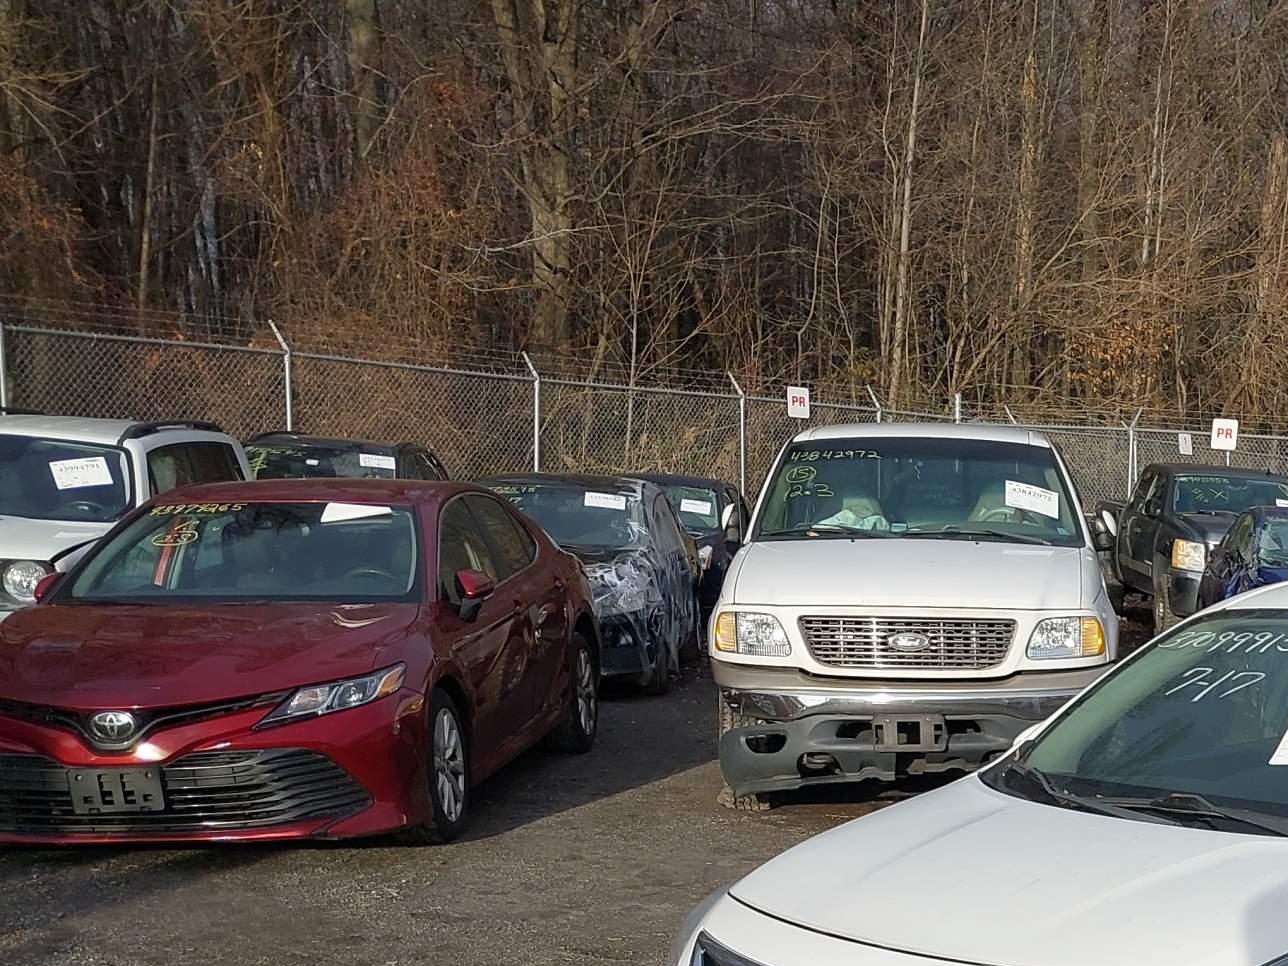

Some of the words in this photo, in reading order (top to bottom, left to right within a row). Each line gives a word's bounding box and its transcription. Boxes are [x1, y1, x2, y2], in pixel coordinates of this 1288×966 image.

[792, 396, 806, 407] PR
[1217, 428, 1233, 438] PR
[791, 450, 882, 462] 43842972
[1164, 667, 1266, 702] 7-17
